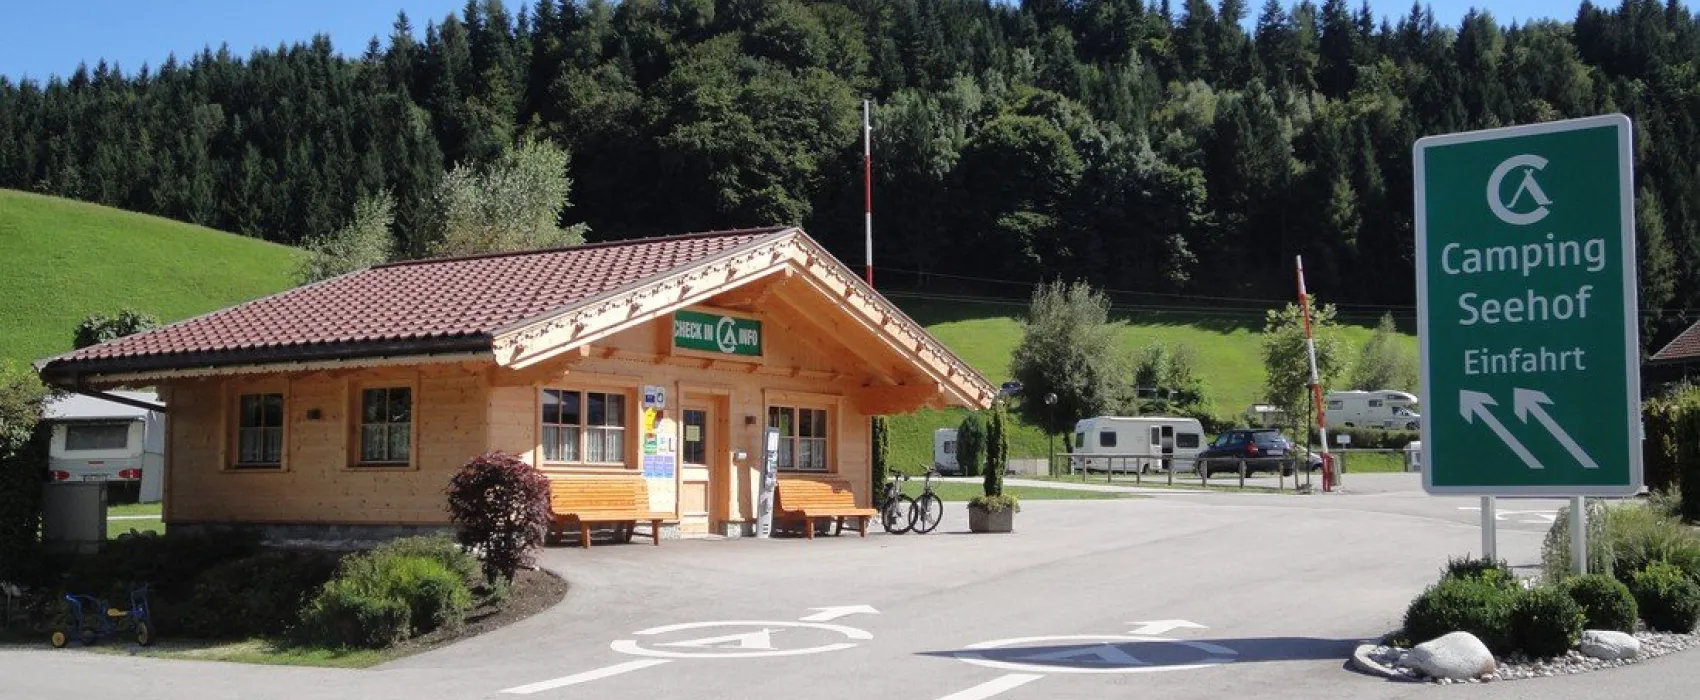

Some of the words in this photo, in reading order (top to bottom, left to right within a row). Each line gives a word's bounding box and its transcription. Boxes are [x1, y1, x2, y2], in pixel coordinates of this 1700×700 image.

[1441, 233, 1606, 277] Camping
[1458, 285, 1593, 326] Seehof
[674, 320, 702, 340] CHECK
[704, 324, 713, 341] IN
[738, 328, 759, 346] INFO
[1464, 346, 1586, 375] Einfahrt
